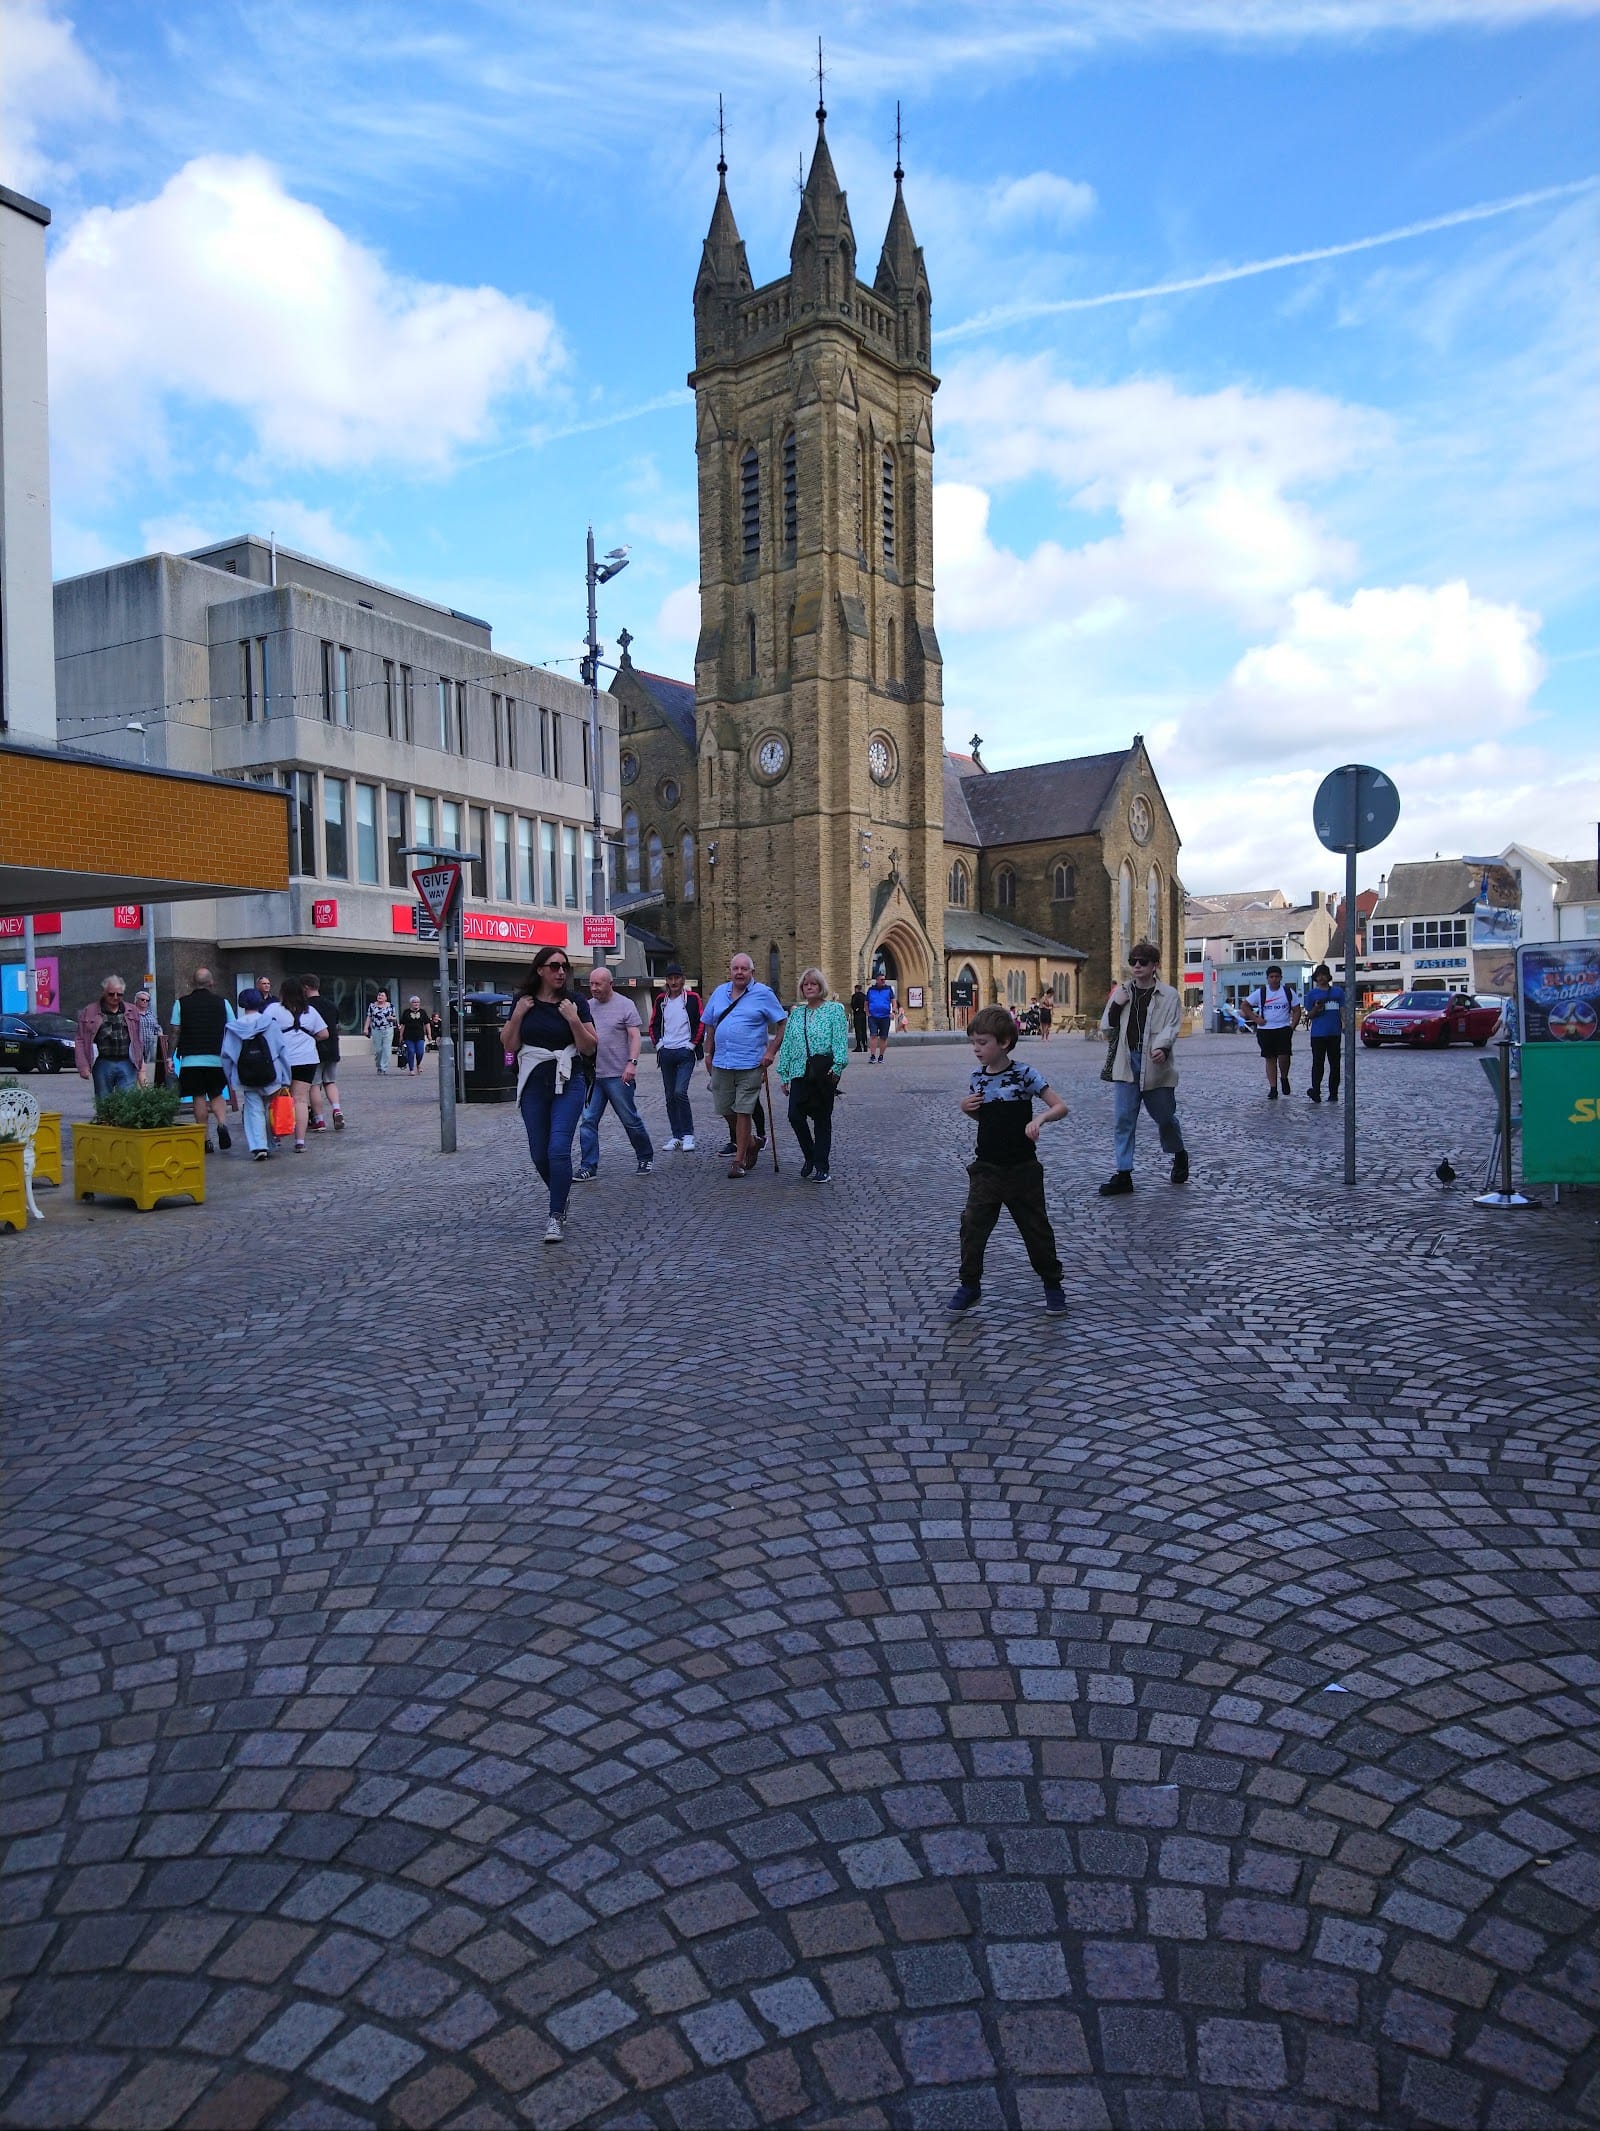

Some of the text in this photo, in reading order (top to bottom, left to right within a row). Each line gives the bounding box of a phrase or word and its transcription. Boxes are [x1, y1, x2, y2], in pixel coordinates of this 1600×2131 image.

[422, 873, 449, 888] GIVE
[429, 890, 445, 899] WAY
[0, 917, 24, 933] NEY
[118, 914, 138, 925] NEY
[317, 914, 333, 924] NEY
[463, 917, 535, 939] GIN MONEY
[1415, 959, 1466, 969] PASTELS
[1568, 1098, 1600, 1124] S
